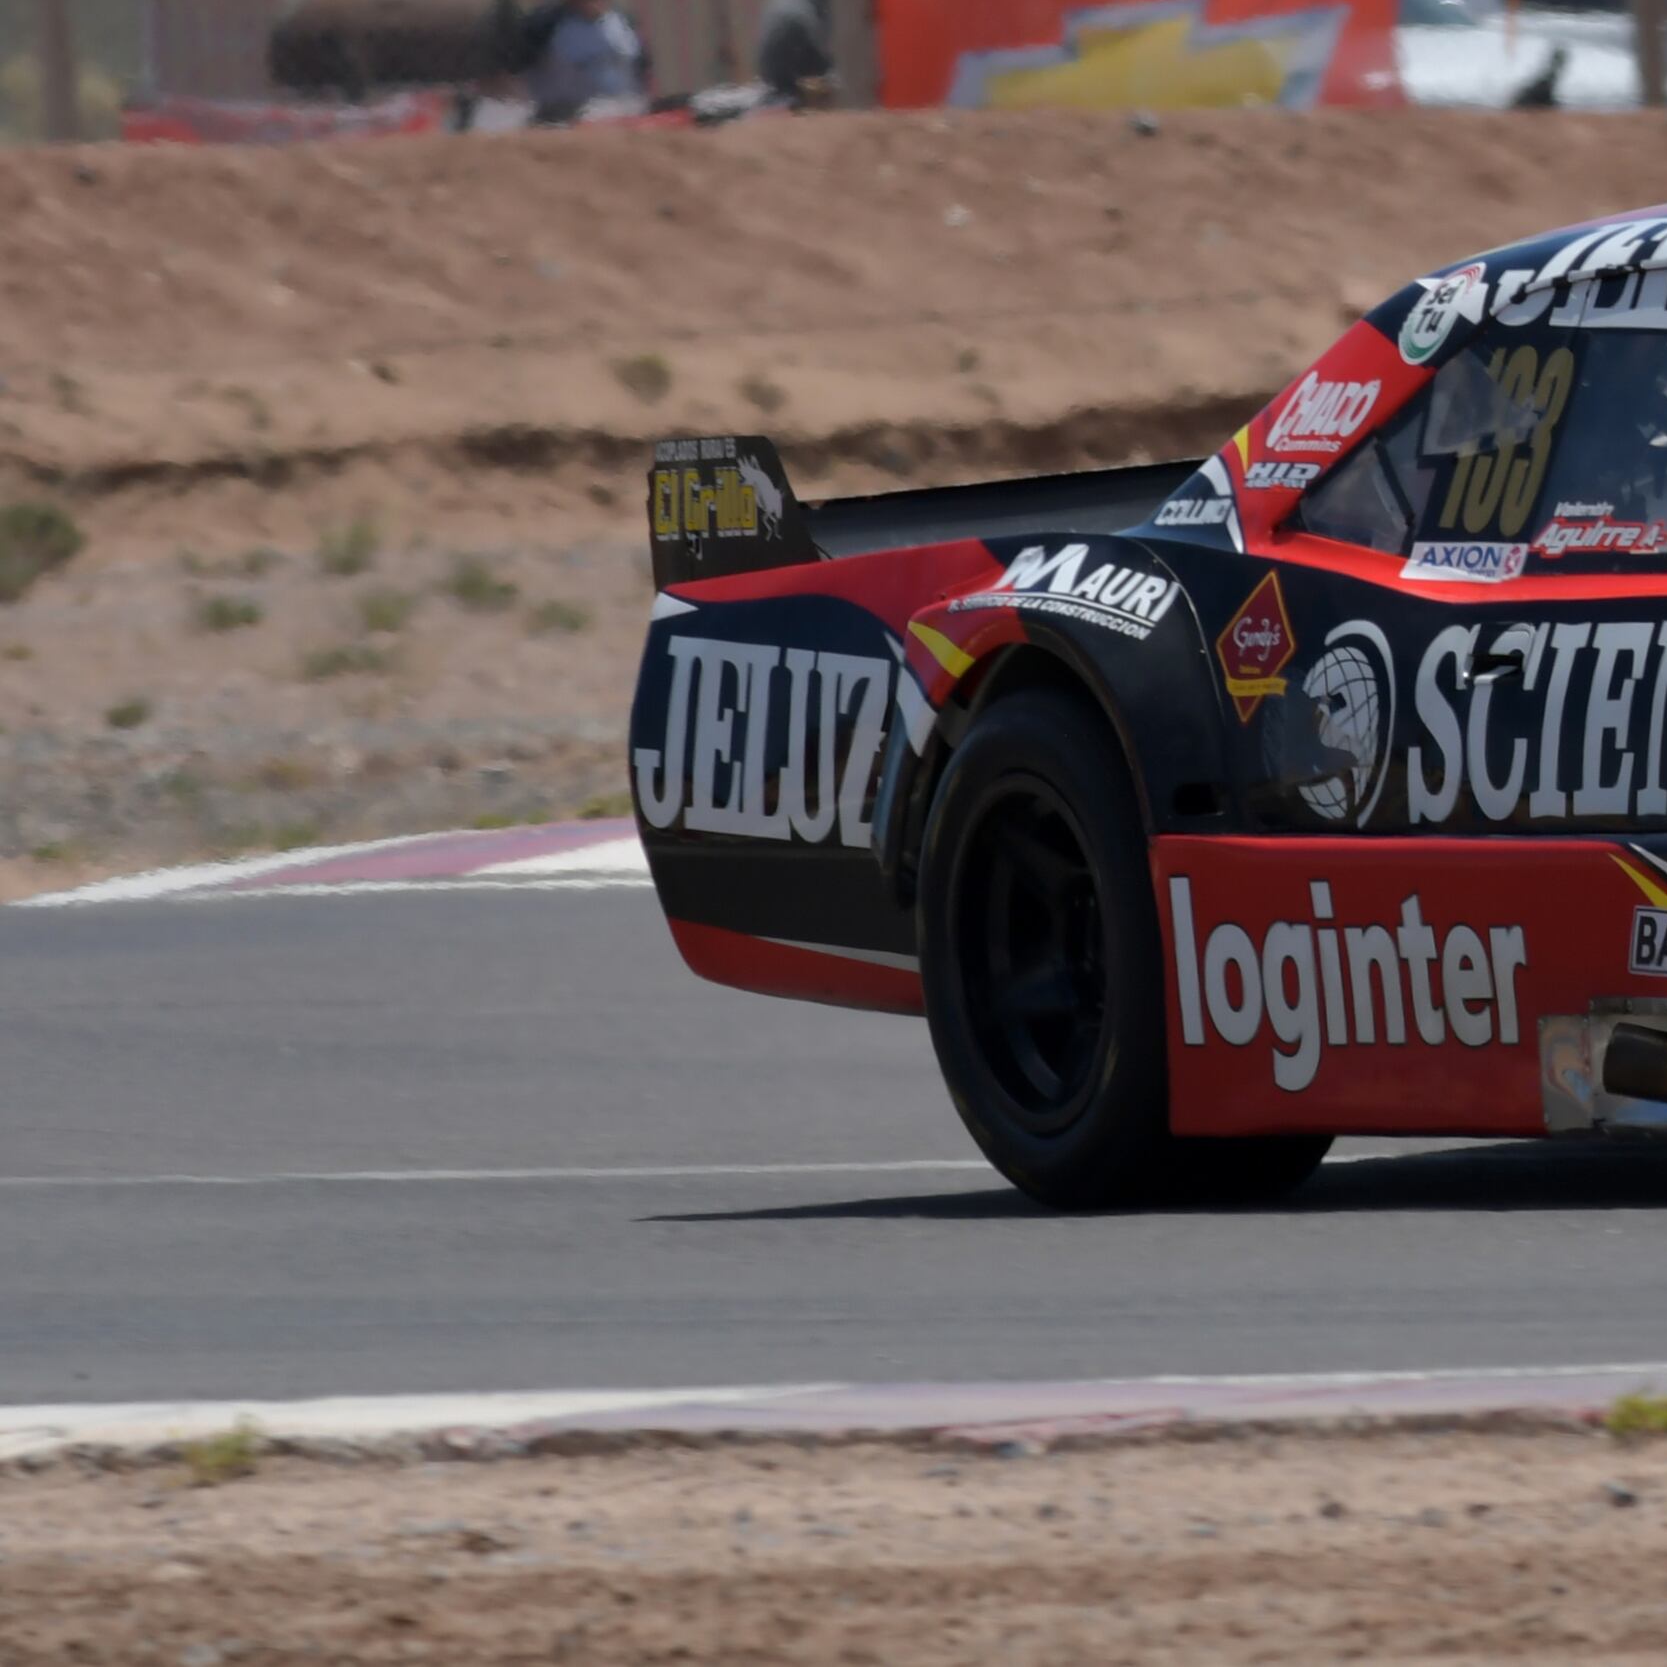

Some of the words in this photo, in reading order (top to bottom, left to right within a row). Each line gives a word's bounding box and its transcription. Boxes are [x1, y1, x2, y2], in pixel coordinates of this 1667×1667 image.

[1418, 545, 1501, 568] AXION
[1534, 521, 1642, 555] Aguirre
[992, 543, 1181, 622] MAURI
[633, 634, 890, 849] JELUZ
[1168, 877, 1527, 1091] loginter
